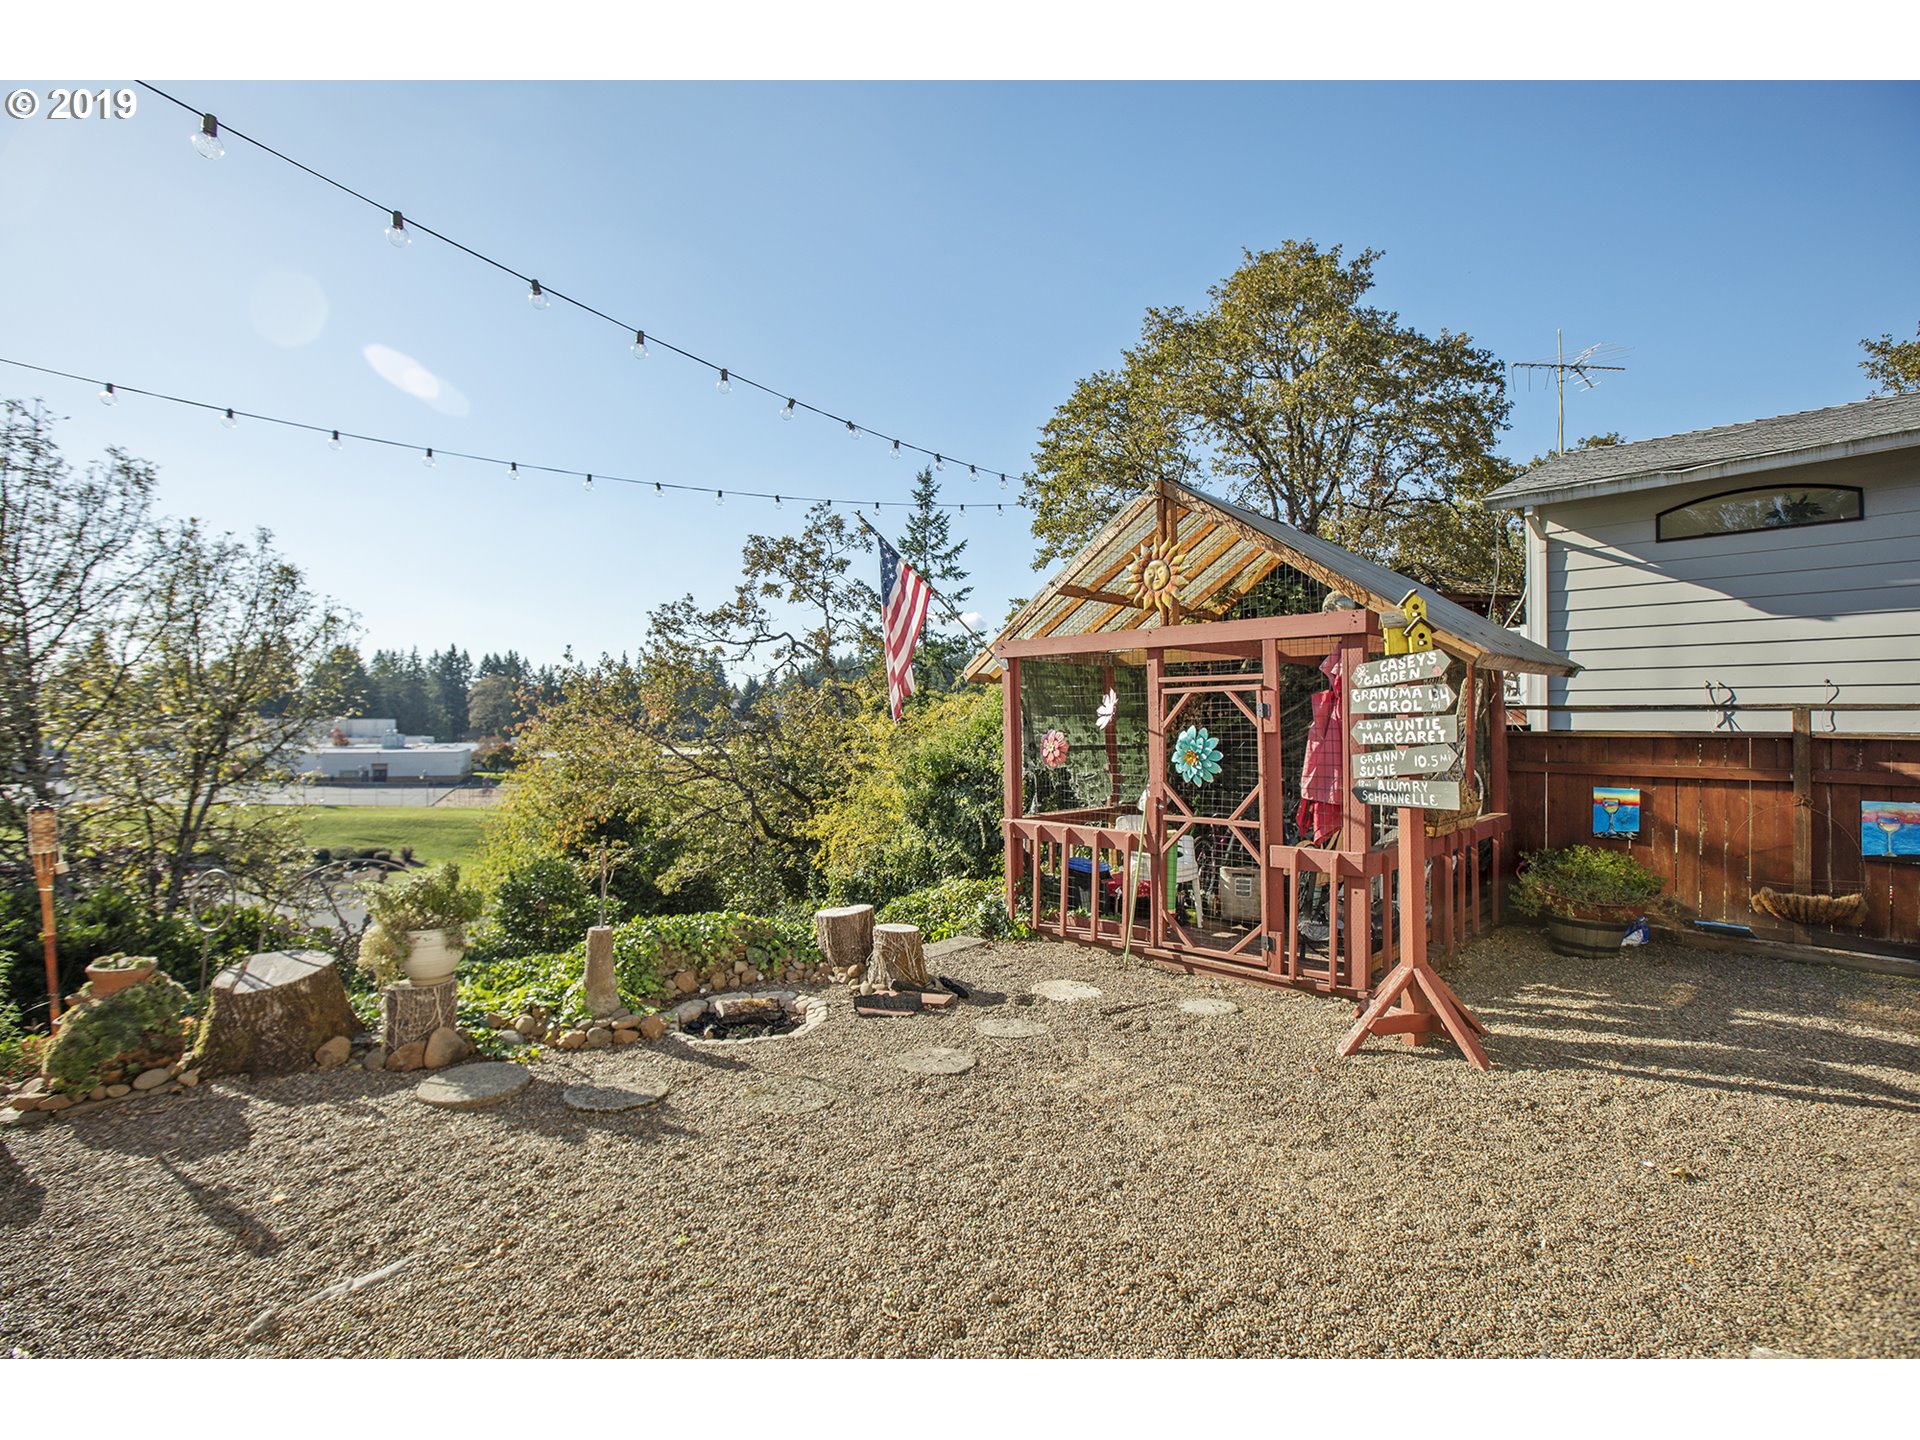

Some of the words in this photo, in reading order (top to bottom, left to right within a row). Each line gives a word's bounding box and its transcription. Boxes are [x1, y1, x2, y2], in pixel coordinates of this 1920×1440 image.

[1380, 652, 1437, 672] CASEY'S
[1364, 668, 1420, 685] GARDEN
[1352, 688, 1422, 702] GRANDMA
[1428, 687, 1450, 706] 134
[1368, 700, 1422, 713] CAROL
[1383, 717, 1442, 731] AUNTIE
[1362, 730, 1446, 744] MARGARET
[1360, 750, 1406, 764] GRANNY
[1414, 754, 1439, 768] 10.5
[1360, 764, 1396, 776] SUSIE
[1362, 790, 1438, 806] SCHANNELLE
